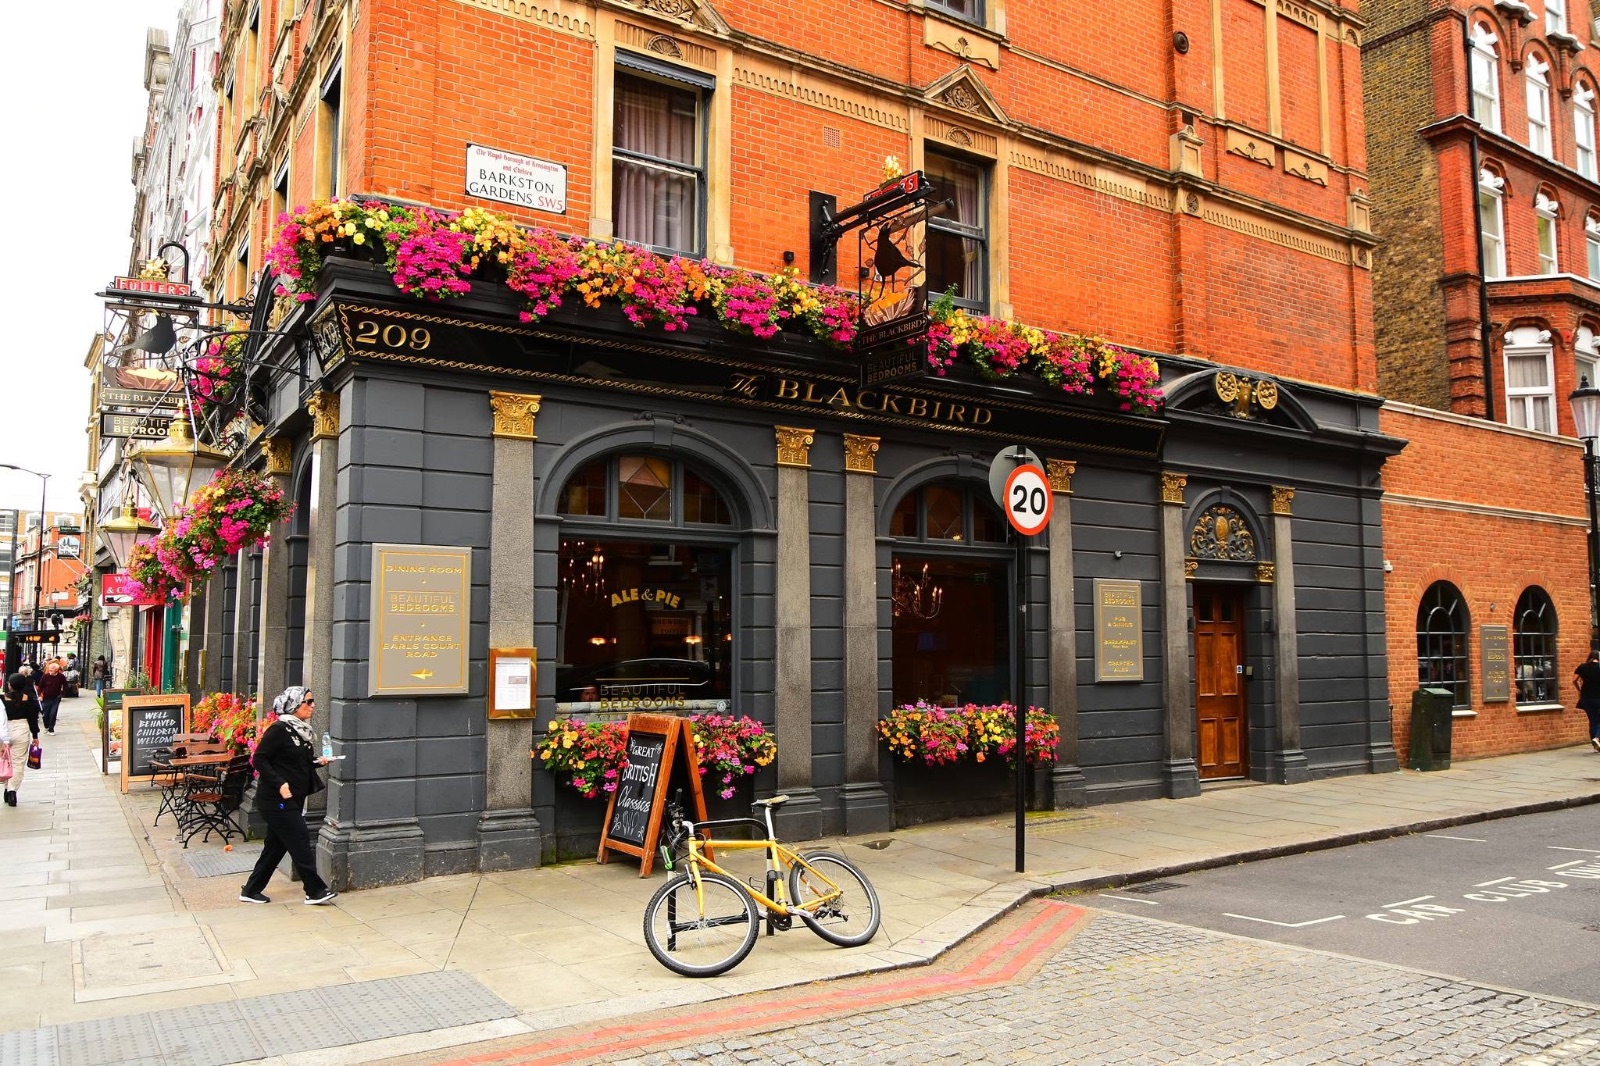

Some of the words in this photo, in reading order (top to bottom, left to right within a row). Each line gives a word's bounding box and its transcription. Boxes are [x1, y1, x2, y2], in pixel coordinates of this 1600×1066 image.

[480, 168, 554, 194] BARKSTON
[356, 321, 431, 350] 209
[862, 334, 876, 344] THE
[879, 319, 922, 339] BLACKBIRD
[867, 351, 916, 372] BEAUTIFUL
[867, 361, 917, 383] BEDROOMS
[107, 393, 130, 401] THE
[723, 372, 766, 398] The
[775, 378, 992, 425] BLACKBIRD
[114, 416, 170, 427] BEAUTIF
[114, 425, 170, 435] BEDROO
[1013, 485, 1045, 516] 20
[391, 594, 455, 604] BEAUTIFUL
[391, 603, 455, 612] BEDROOMS
[611, 588, 639, 608] ALE
[641, 588, 654, 601] &
[655, 590, 680, 609] PIE
[600, 684, 685, 696] BEAUTIFUL
[600, 696, 685, 709] BEDROOMS
[137, 727, 178, 736] CHILDREN
[139, 719, 176, 728] BEHAVED
[137, 736, 173, 745] WELCOM
[632, 745, 655, 758] GREAT
[622, 759, 658, 787] BRITISH
[618, 785, 650, 812] Classics
[1463, 879, 1568, 902] CLUB
[1365, 904, 1466, 925] CAR
